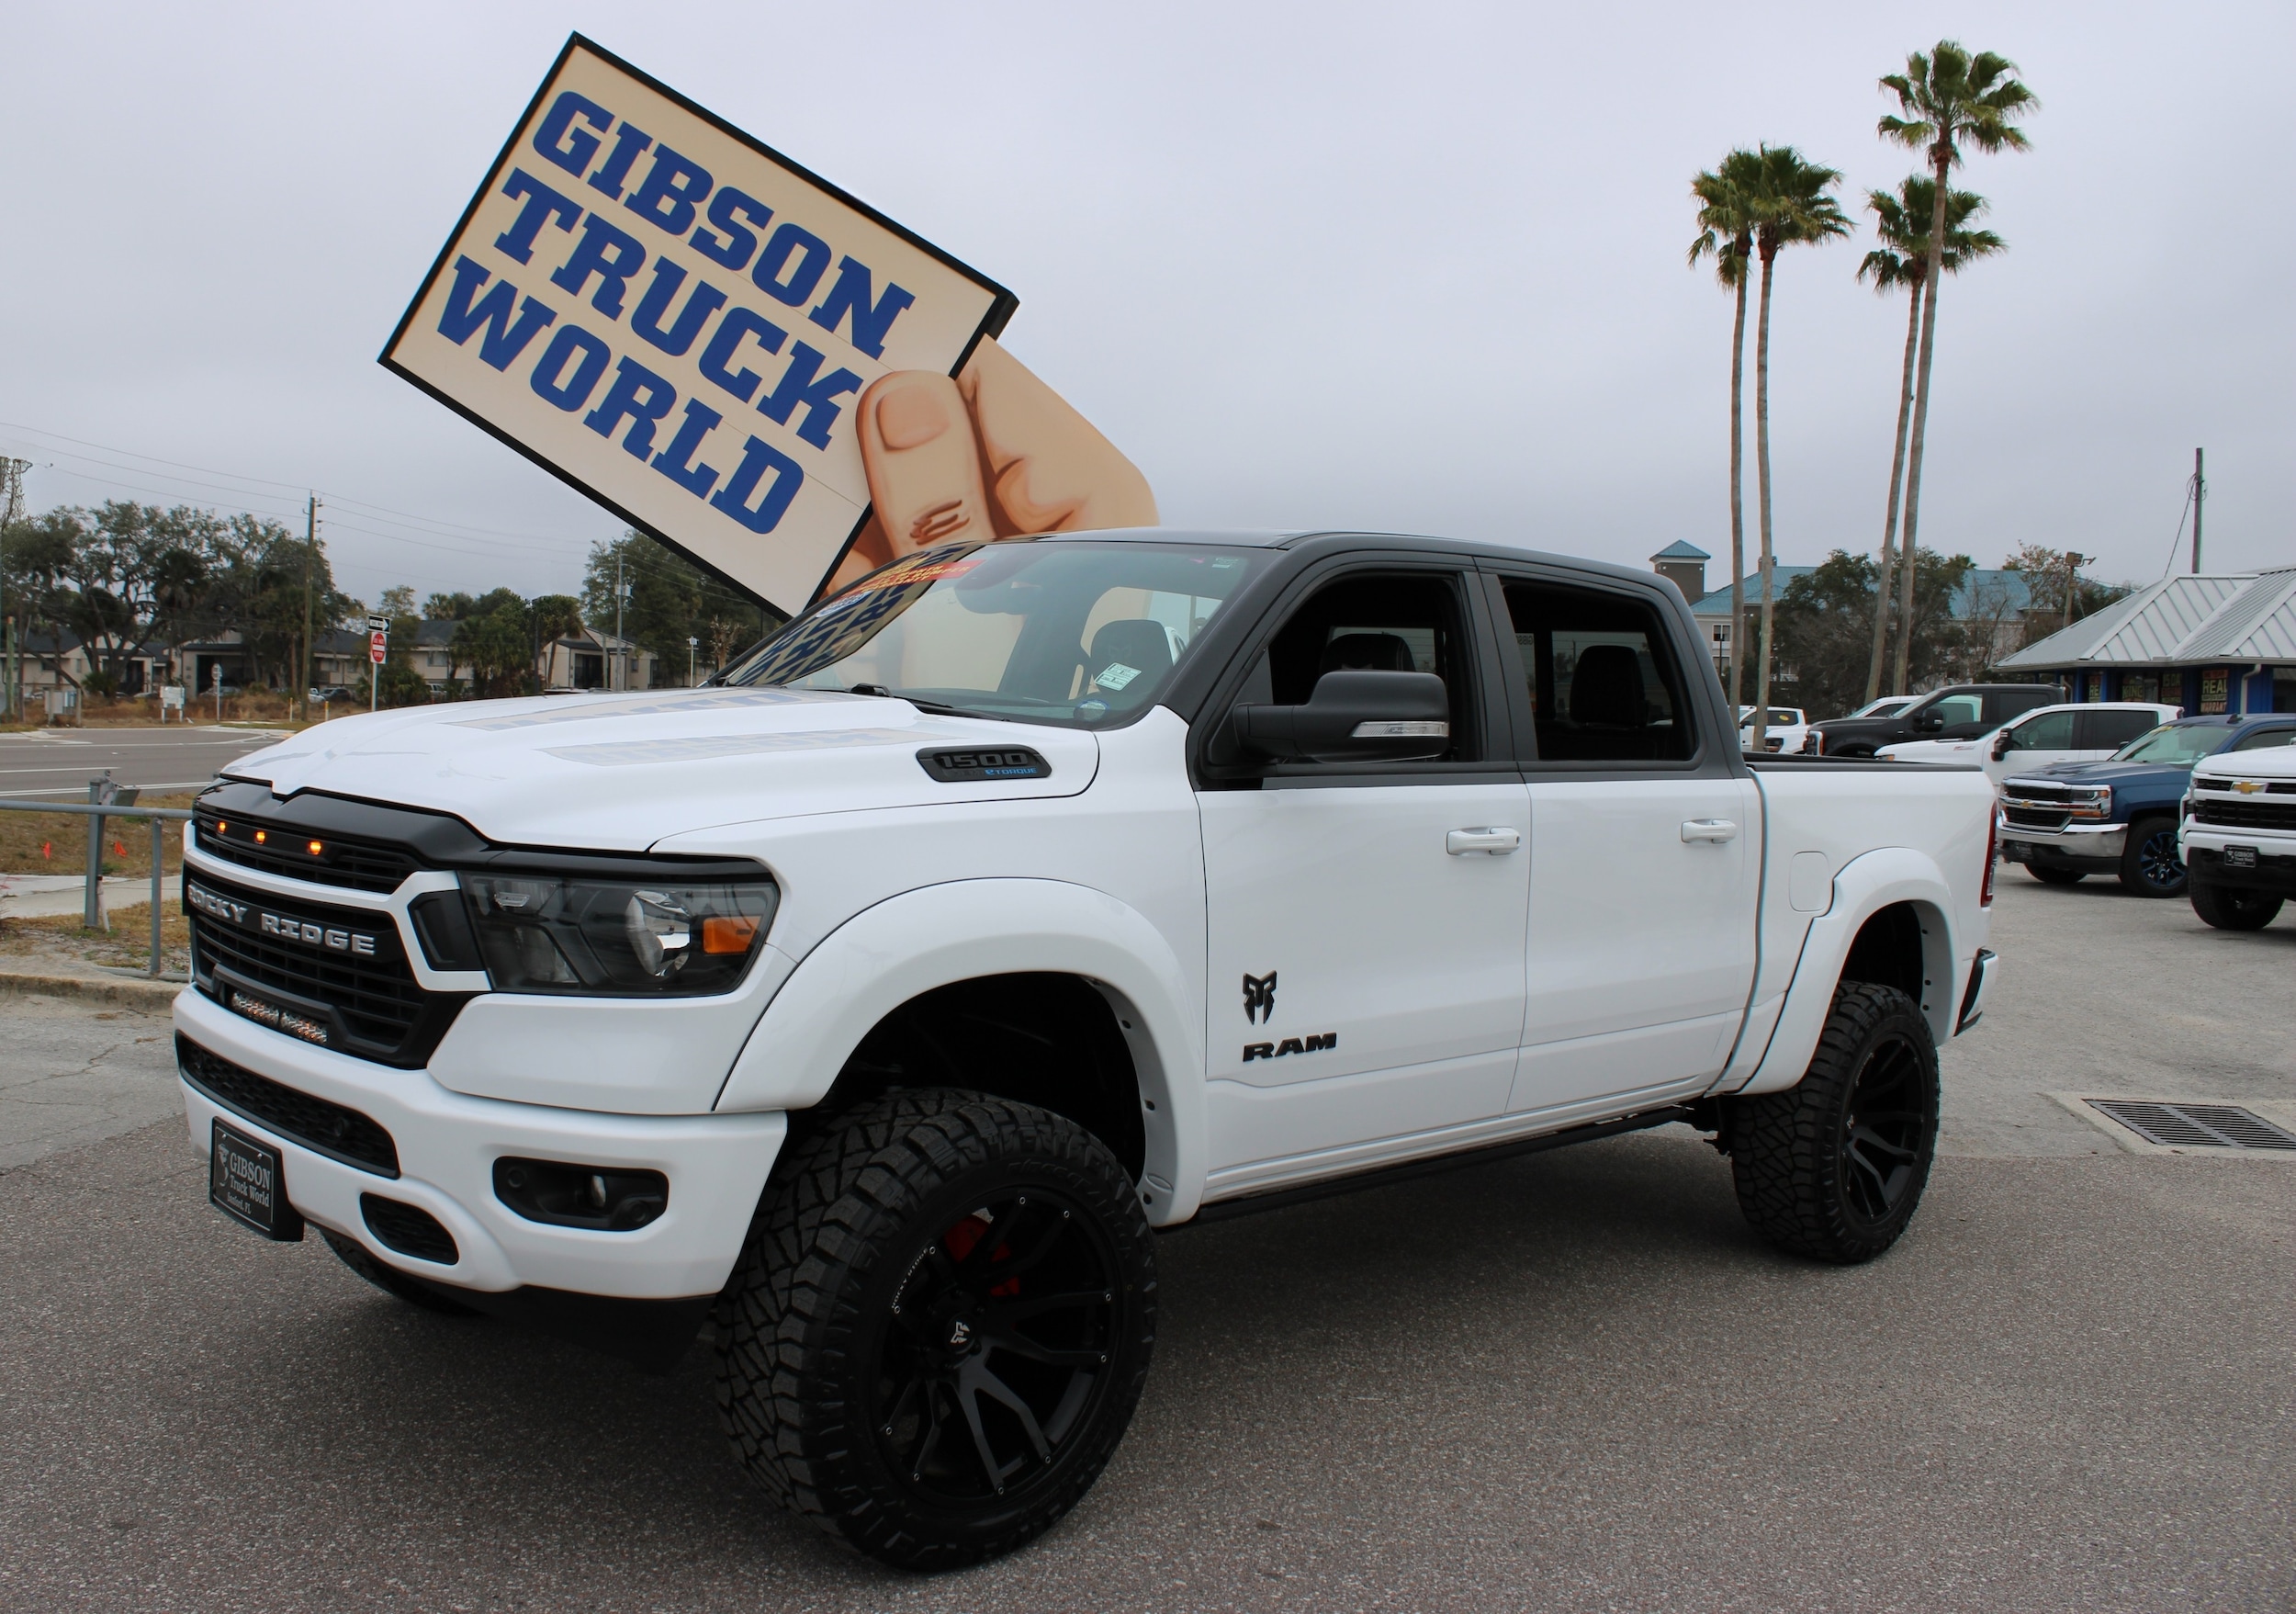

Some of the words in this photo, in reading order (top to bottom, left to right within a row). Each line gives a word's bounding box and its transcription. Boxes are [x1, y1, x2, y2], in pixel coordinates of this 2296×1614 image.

[533, 90, 916, 360] GIBSON
[494, 166, 864, 452] TRUCK
[436, 254, 805, 536] WORLD
[2089, 684, 2100, 696] RE
[940, 752, 1029, 769] 1500
[188, 884, 248, 923] ROCKY
[261, 912, 375, 956] RIDGE
[1243, 1032, 1336, 1062] RAM
[230, 1152, 271, 1191] GIBSON
[230, 1174, 248, 1197] Truck
[249, 1184, 270, 1208] World
